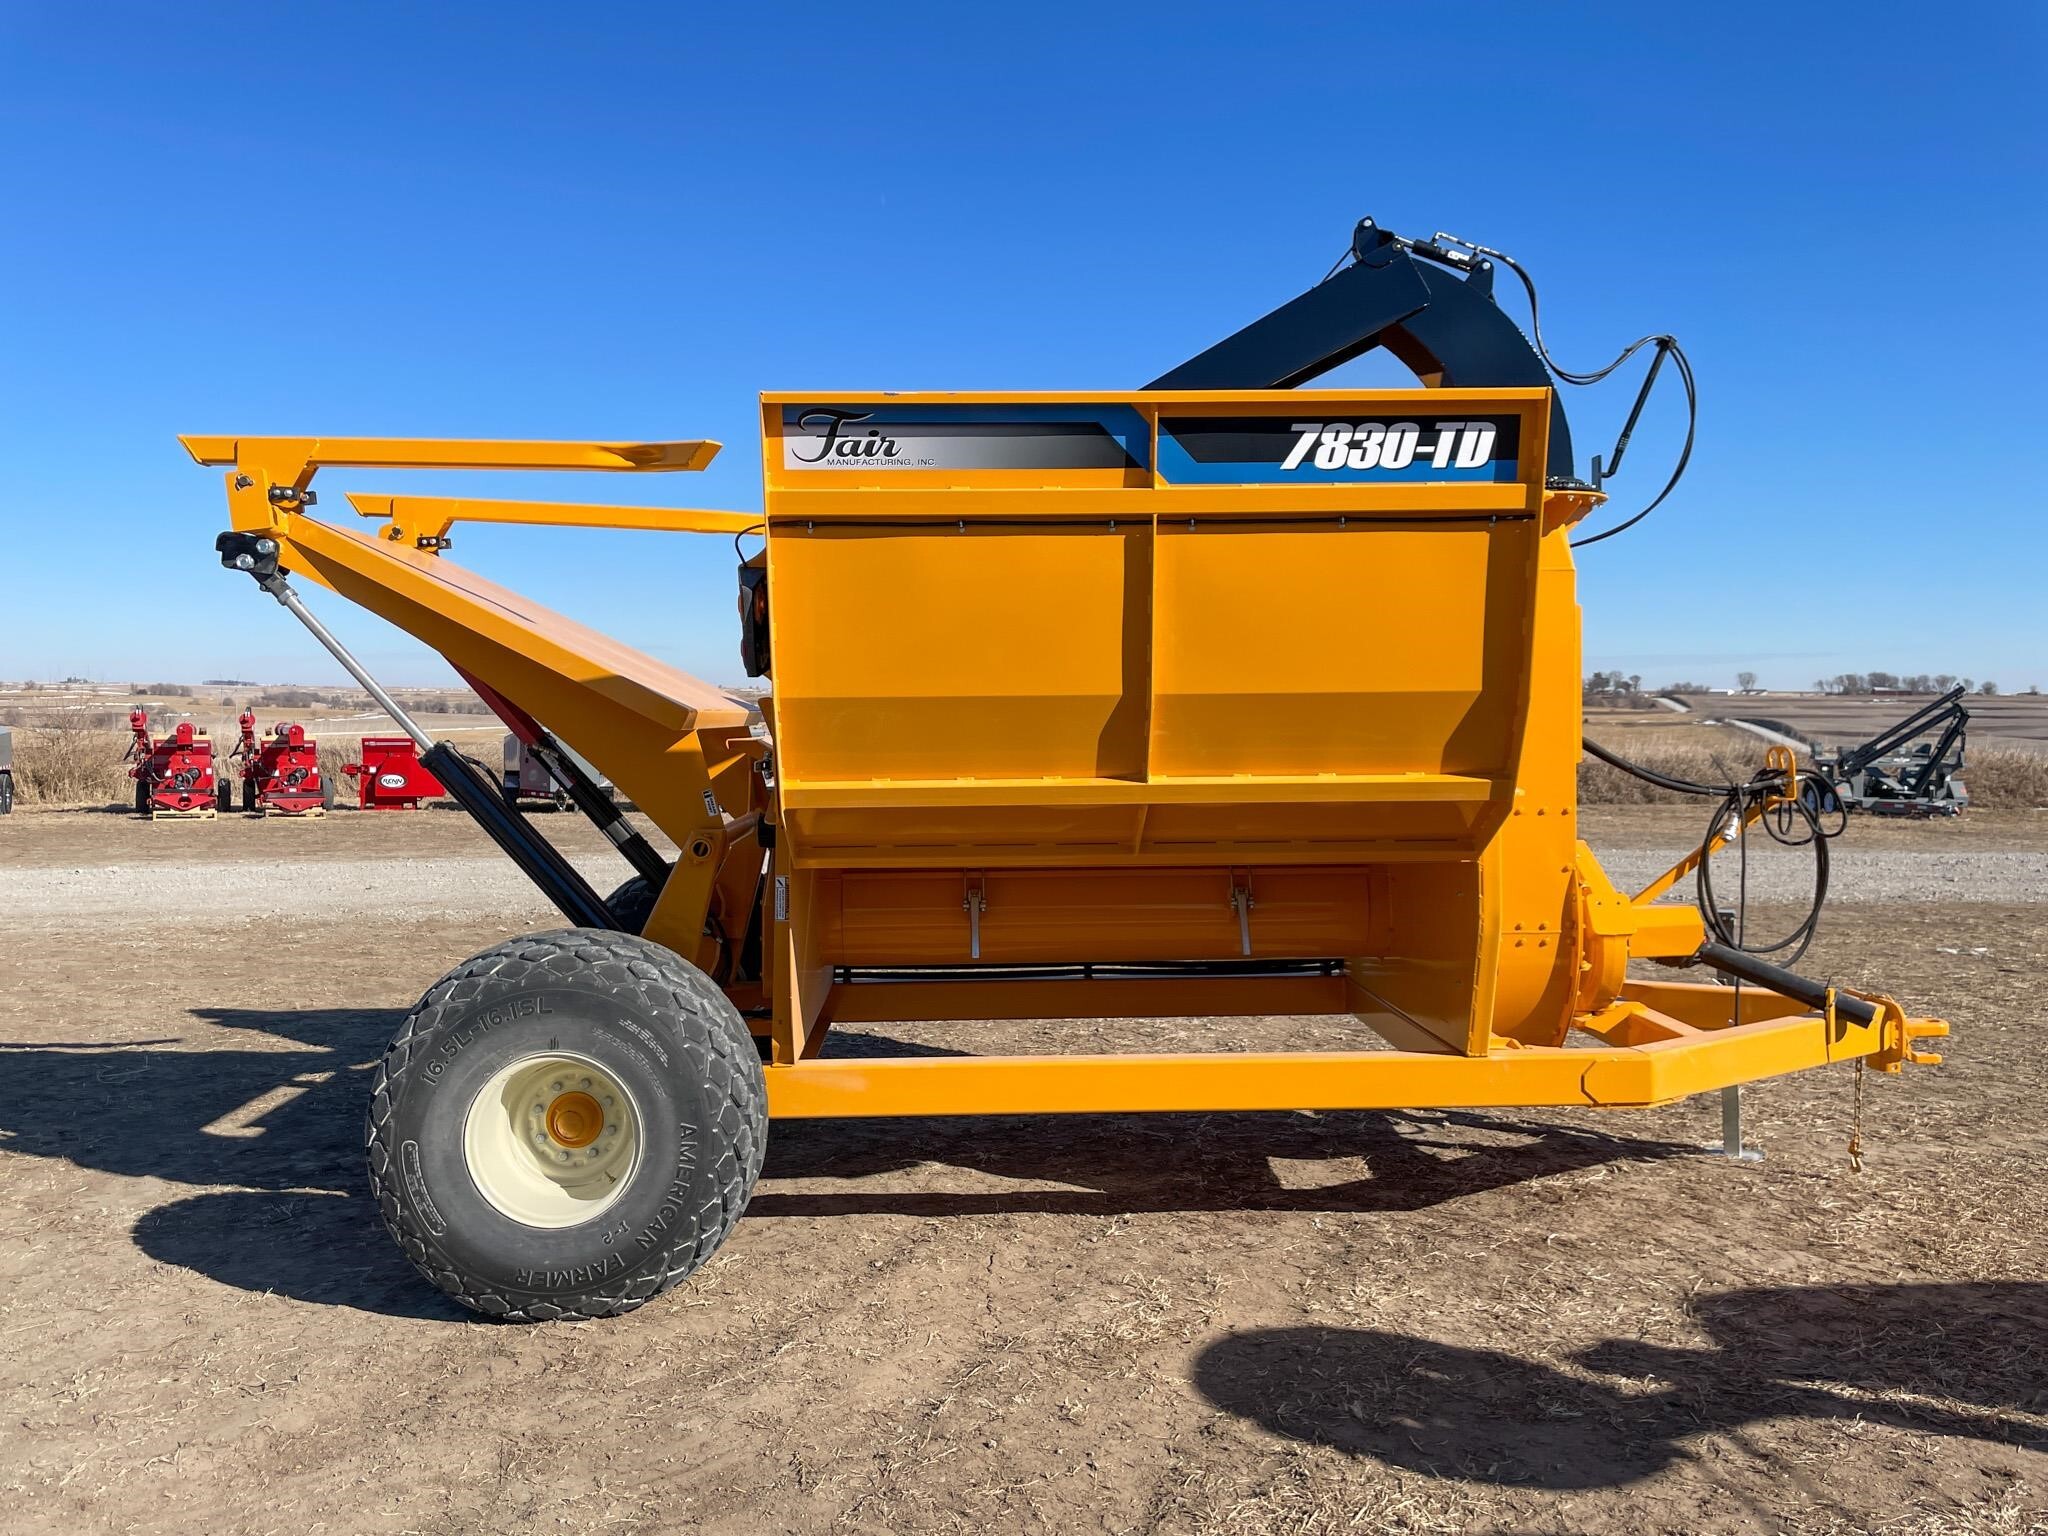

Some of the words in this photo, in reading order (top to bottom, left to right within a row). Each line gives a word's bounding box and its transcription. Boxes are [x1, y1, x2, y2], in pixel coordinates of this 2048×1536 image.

[791, 407, 902, 463] Fair
[1279, 421, 1498, 470] 7830-TD
[827, 458, 914, 467] MANUFACTURING,
[634, 1122, 698, 1250] AMERICAN
[516, 1252, 626, 1288] FARMER
